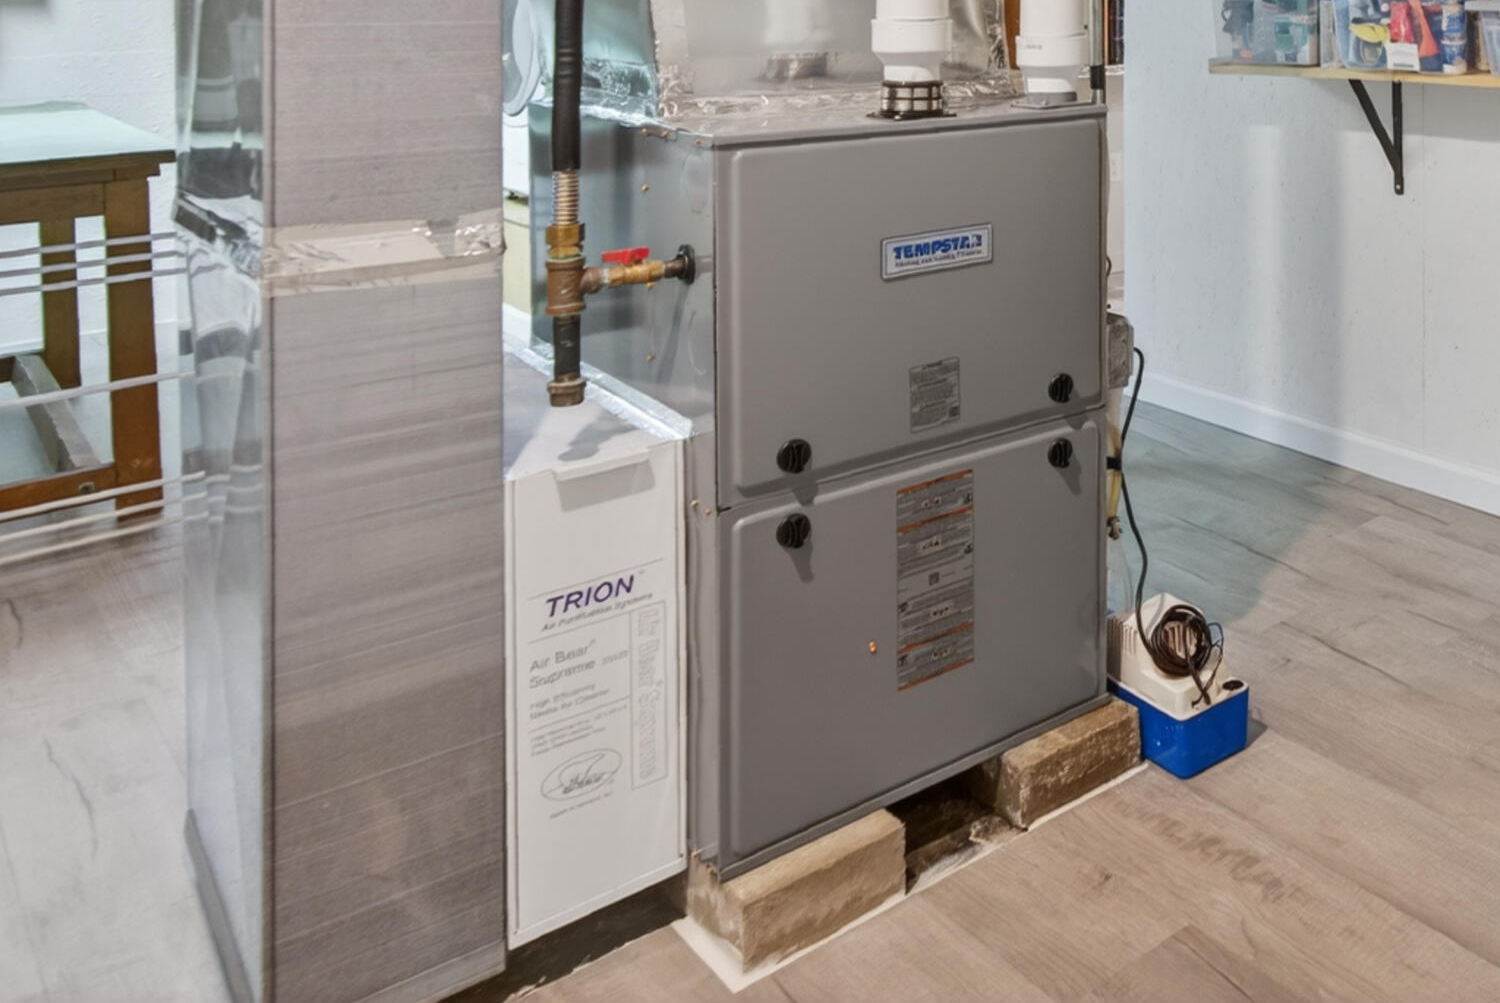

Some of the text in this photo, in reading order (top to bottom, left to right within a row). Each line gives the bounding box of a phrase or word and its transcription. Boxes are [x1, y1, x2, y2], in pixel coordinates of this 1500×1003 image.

[892, 234, 983, 260] TEMPSTAR
[545, 574, 635, 618] TRION
[529, 657, 551, 673] Air
